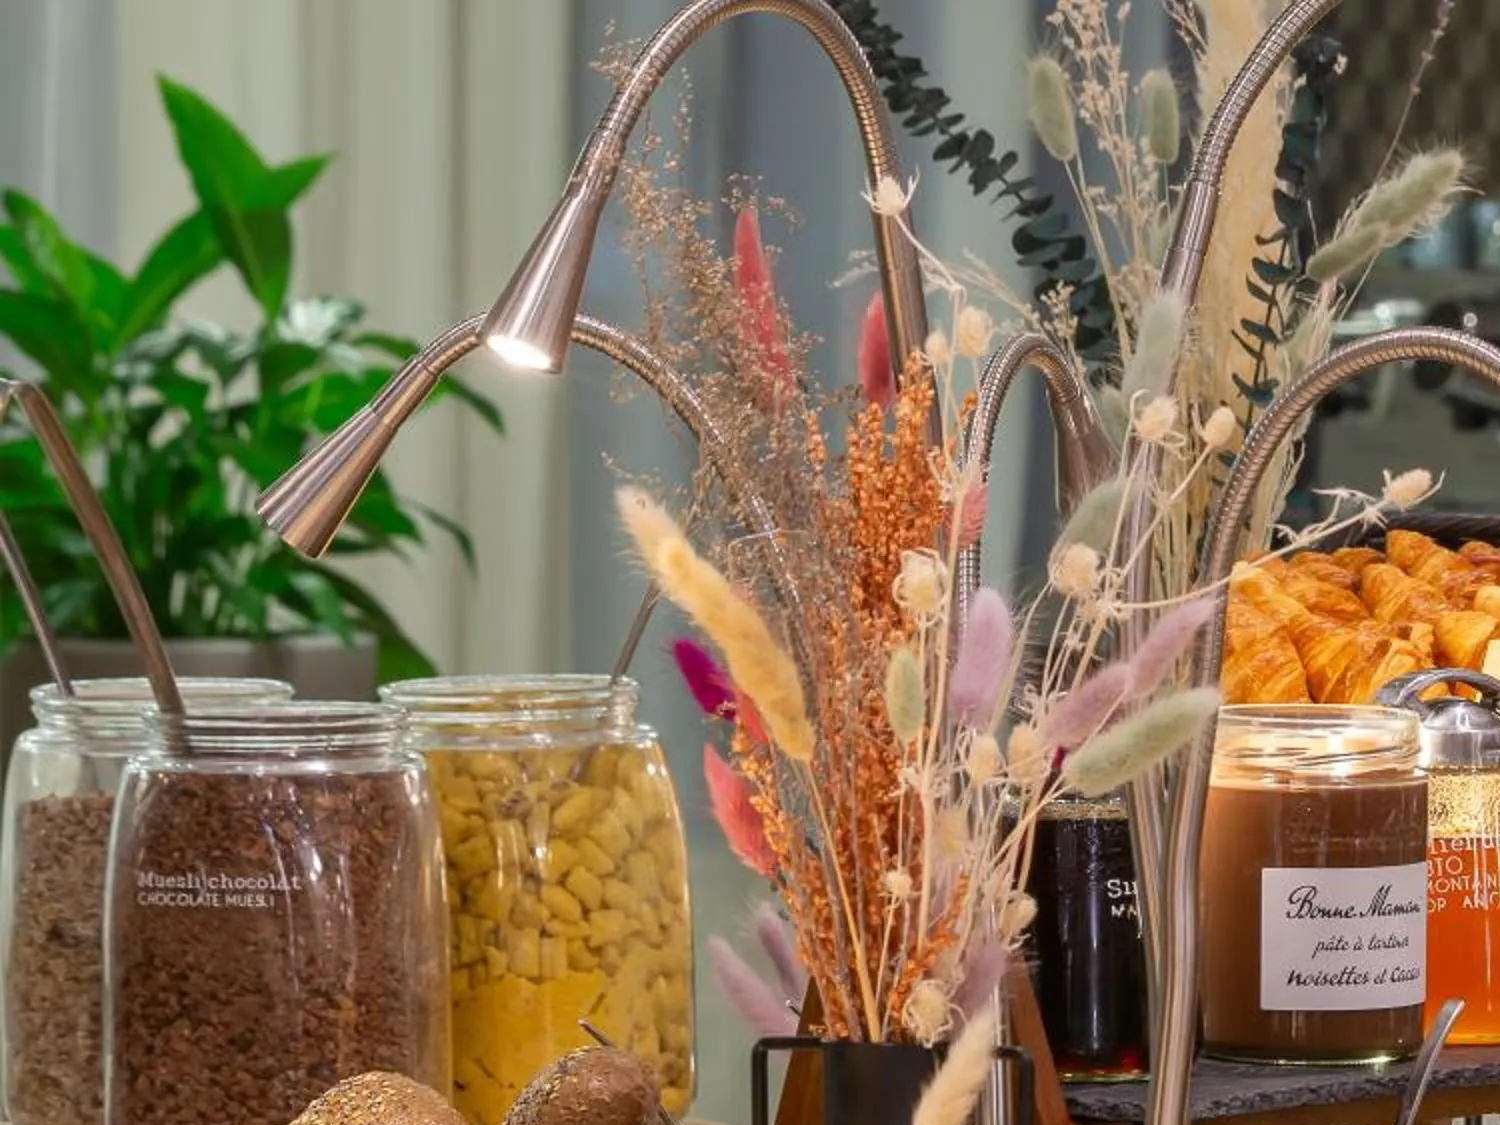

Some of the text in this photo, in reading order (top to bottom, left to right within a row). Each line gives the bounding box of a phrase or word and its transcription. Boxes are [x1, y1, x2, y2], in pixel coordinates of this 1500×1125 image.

[136, 870, 302, 890] Muesli chocolat
[136, 891, 275, 909] CHOCOLATE MUESLI
[1286, 884, 1421, 919] Bonne Maman
[1311, 935, 1350, 960] pâte
[1353, 936, 1364, 951] à
[1286, 966, 1369, 987] noisettes
[1373, 968, 1388, 985] et
